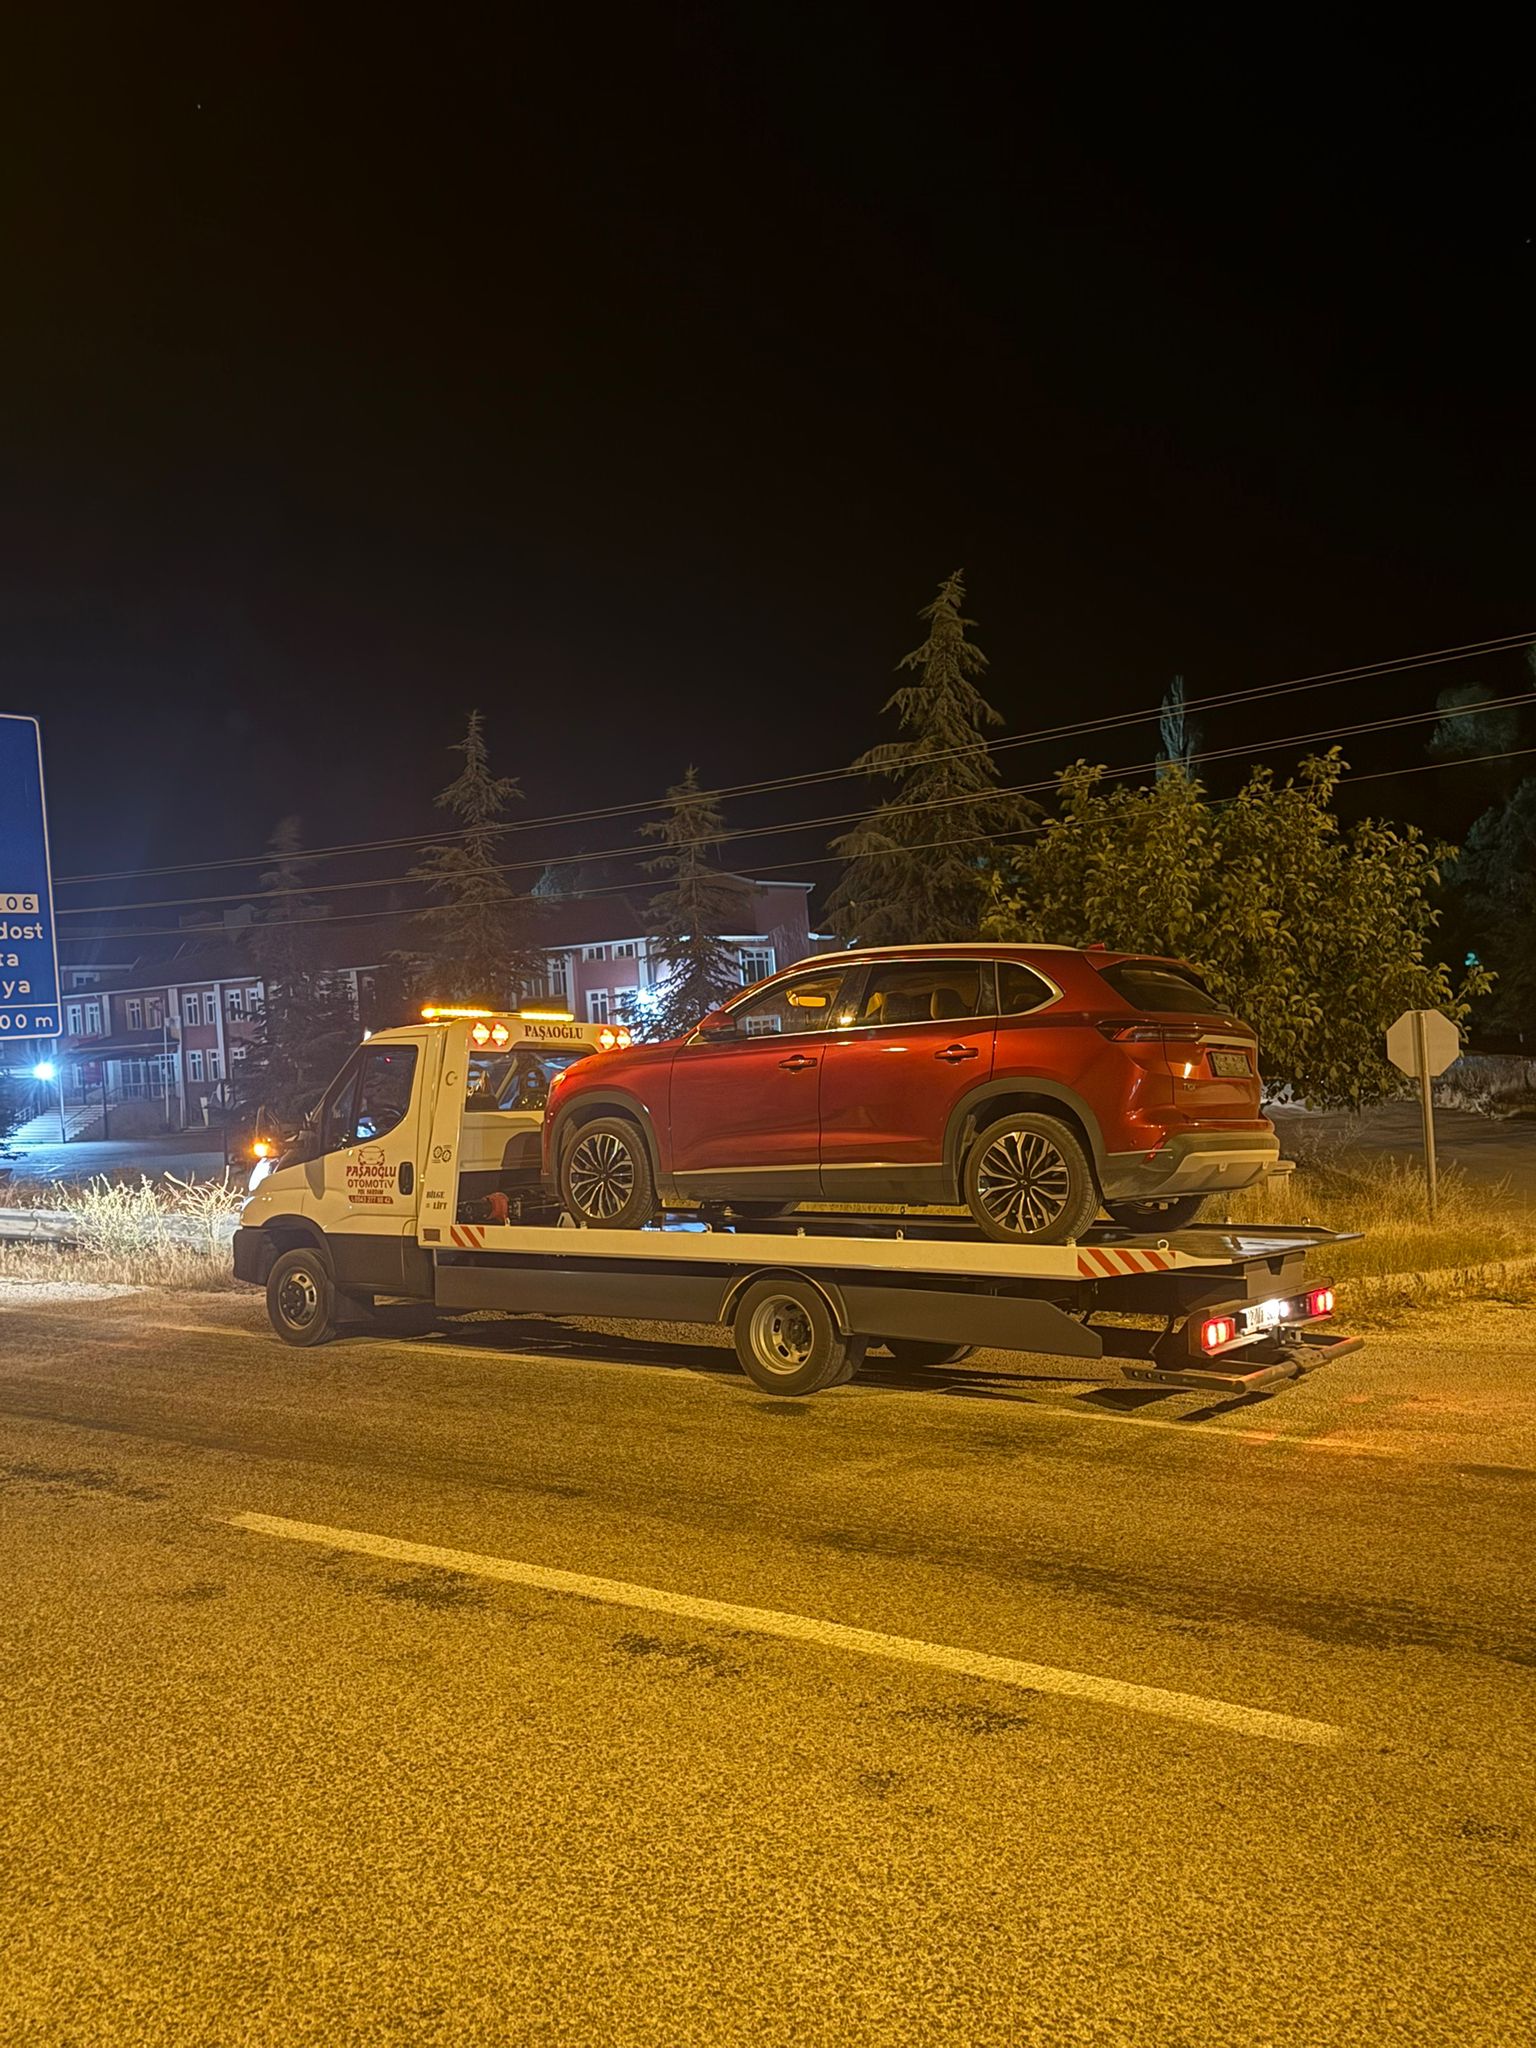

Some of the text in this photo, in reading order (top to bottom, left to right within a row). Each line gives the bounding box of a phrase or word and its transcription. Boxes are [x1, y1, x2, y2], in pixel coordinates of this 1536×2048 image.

[0, 896, 34, 911] 06
[2, 980, 31, 999] ya
[35, 1016, 53, 1028] m
[524, 1024, 583, 1040] PAŞAOĞLU
